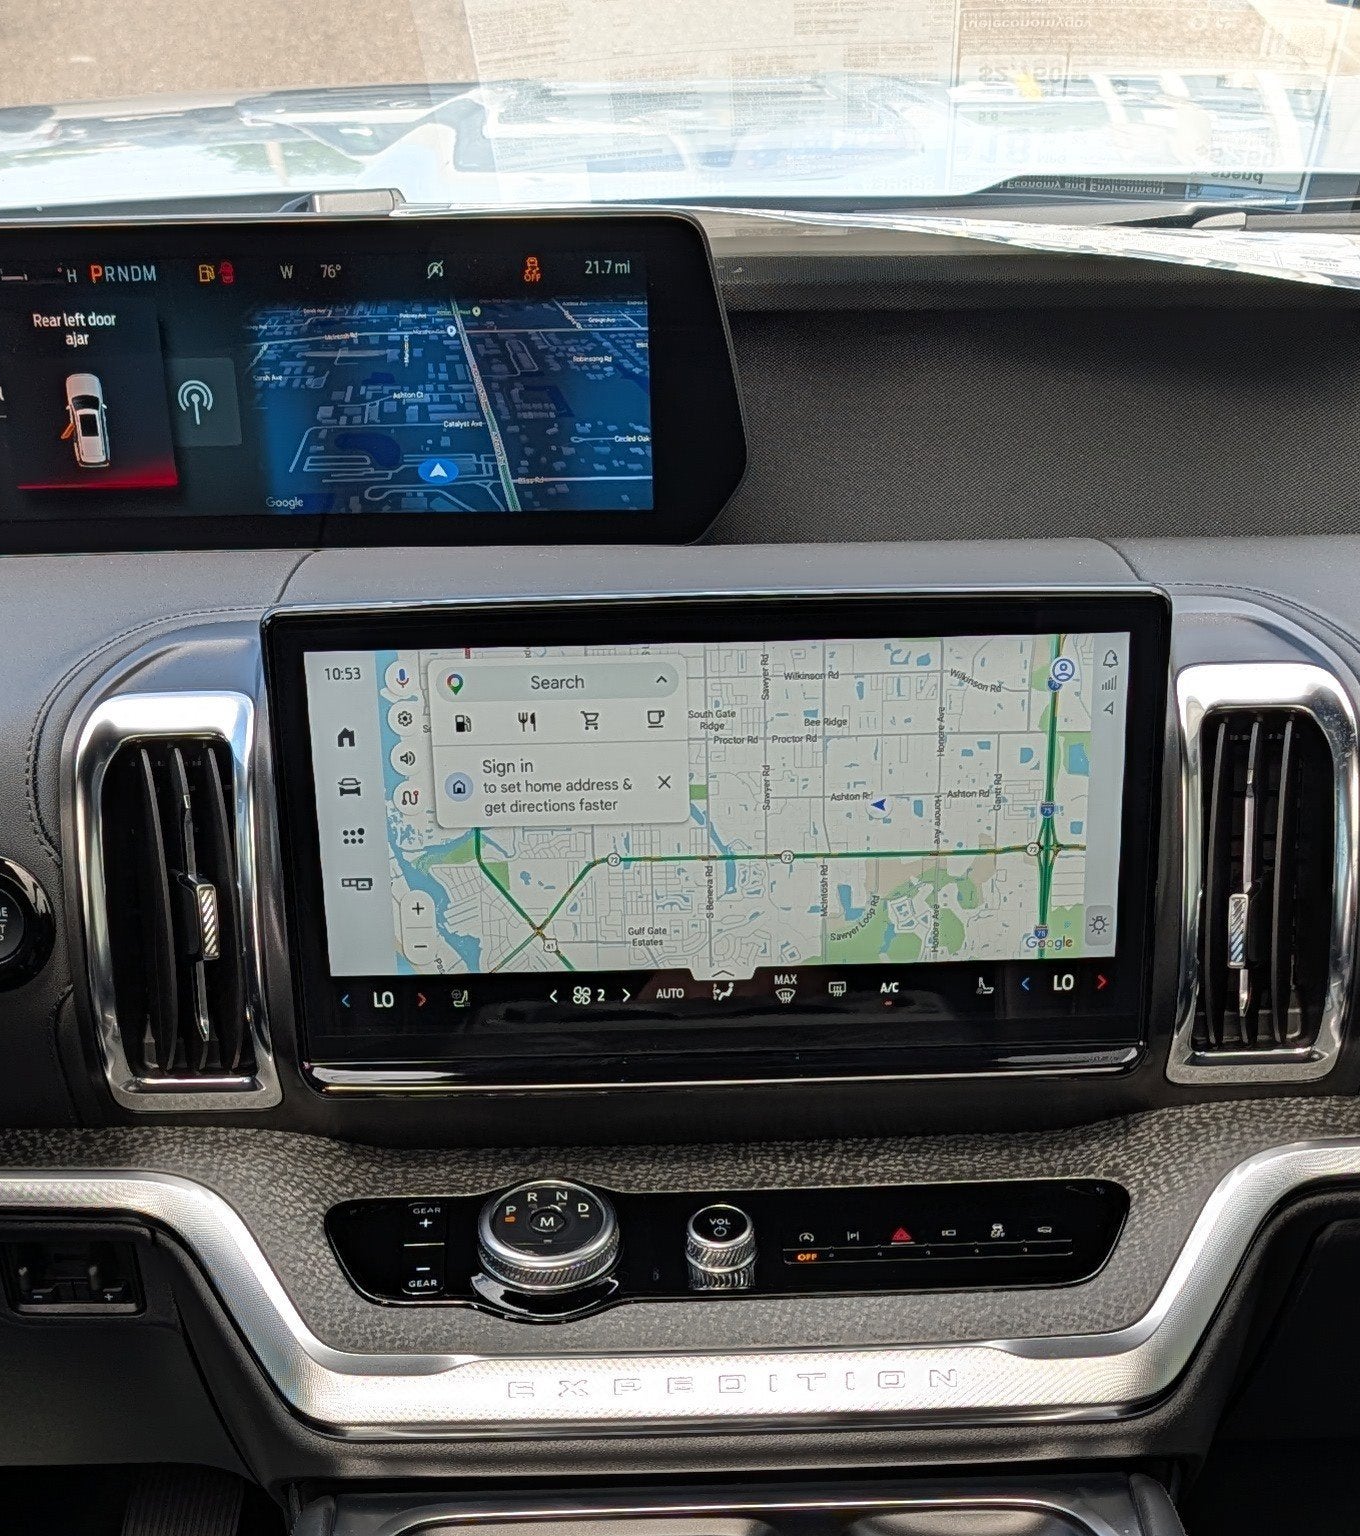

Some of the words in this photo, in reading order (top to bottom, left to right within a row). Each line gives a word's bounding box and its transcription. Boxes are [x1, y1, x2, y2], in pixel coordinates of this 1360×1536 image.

[280, 264, 293, 279] W
[320, 264, 342, 279] 76°
[584, 260, 612, 275] 21.7
[614, 260, 631, 275] mi
[33, 313, 62, 328] Rear
[63, 312, 86, 328] left
[87, 312, 116, 327] door
[64, 330, 89, 349] ajar
[392, 391, 415, 400] Ashton
[443, 420, 469, 429] Catalyst
[265, 496, 304, 510] Google
[761, 654, 770, 666] Rd
[324, 667, 362, 681] 10:53
[783, 672, 825, 681] Wilkinson
[827, 671, 840, 680] Rd
[950, 668, 989, 692] Wilkinson
[990, 684, 1002, 693] Rd
[530, 675, 585, 691] Search
[761, 670, 770, 700] Sawyer
[688, 710, 714, 718] South
[715, 709, 737, 718] Gate
[699, 722, 725, 732] Ridge
[804, 719, 821, 727] Bee
[822, 718, 848, 728] Ridge
[713, 736, 746, 744] Proctor
[747, 735, 759, 744] Rd
[771, 735, 805, 744] Proctor
[806, 734, 818, 743] Rd
[481, 758, 516, 778] Sign
[517, 758, 534, 774] in
[762, 764, 771, 777] Rd
[483, 781, 498, 794] to
[499, 781, 522, 794] set
[524, 779, 563, 793] home
[565, 777, 619, 792] address
[622, 778, 633, 792] &
[994, 773, 1003, 785] Rd
[762, 778, 771, 811] Sawyer
[830, 793, 860, 801] Ashton
[947, 790, 977, 798] Ashton
[978, 789, 990, 798] Rd
[993, 787, 1003, 811] Gantt
[484, 801, 506, 818] get
[509, 799, 576, 815] directions
[578, 798, 619, 812] faster
[705, 865, 714, 878] Rd
[820, 864, 829, 877] Rd
[705, 880, 714, 911] Beneva
[820, 877, 829, 917] McIntosh
[830, 925, 861, 941] Sawyer
[859, 909, 877, 929] Loop
[871, 895, 881, 908] Rd
[932, 904, 940, 919] Ave
[628, 927, 645, 938] Gulf
[646, 926, 668, 937] Gate
[632, 937, 664, 948] Estates
[1025, 935, 1074, 950] Google
[774, 973, 798, 985] MAX
[1053, 974, 1075, 991] LO
[656, 987, 685, 999] AUTO
[880, 981, 900, 994] A/C
[373, 991, 395, 1008] LO
[597, 989, 606, 1002] 2
[527, 1192, 538, 1203] R
[556, 1191, 569, 1202] N
[412, 1206, 441, 1215] GEAR
[505, 1205, 517, 1217] P
[577, 1203, 590, 1214] D
[540, 1216, 555, 1228] M
[709, 1217, 732, 1226] VOL
[797, 1253, 818, 1261] OFF
[408, 1279, 438, 1288] GEAR
[507, 1368, 959, 1399] EXPEDITION
